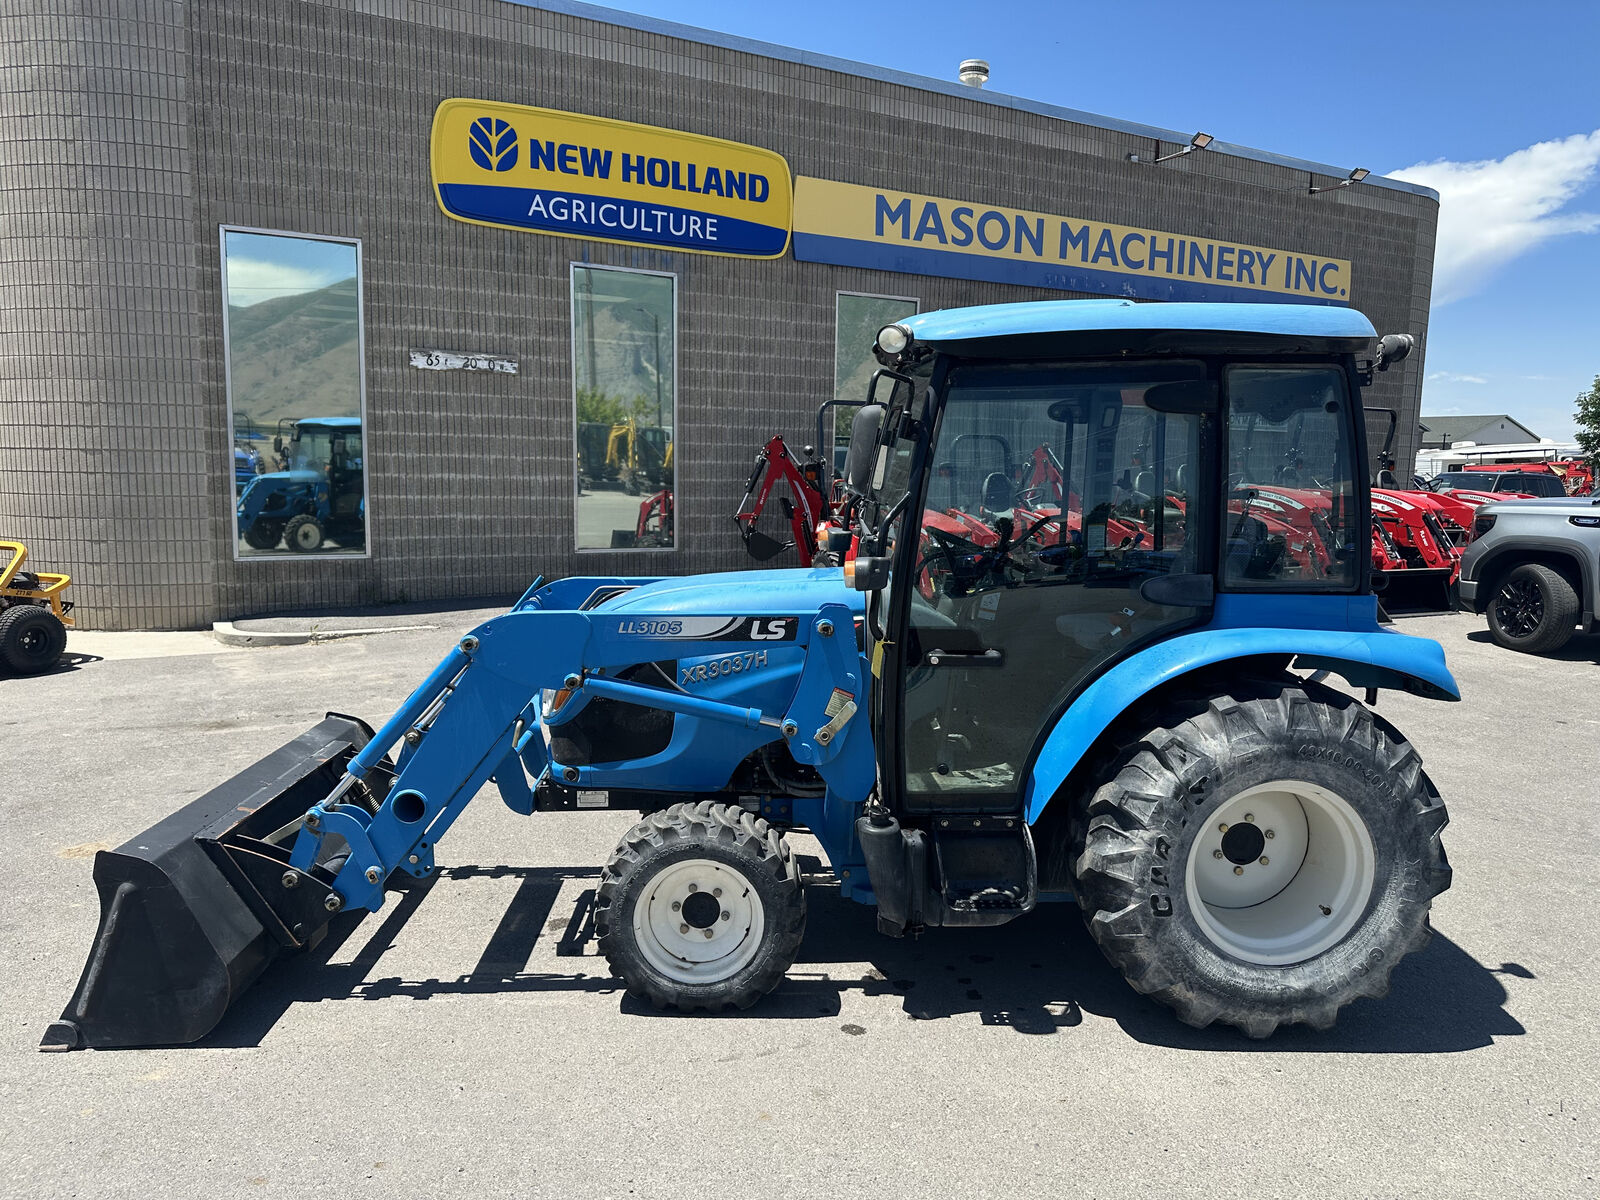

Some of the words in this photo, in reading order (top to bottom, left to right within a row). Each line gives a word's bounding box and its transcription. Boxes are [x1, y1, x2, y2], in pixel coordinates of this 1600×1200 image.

[529, 138, 613, 180] NEW
[621, 152, 770, 203] HOLLAND
[528, 193, 718, 241] AGRICULTURE
[875, 194, 1045, 257] MASON
[1058, 221, 1277, 286] MACHINERY
[1284, 256, 1346, 297] INC.
[618, 621, 683, 634] LL3105
[750, 620, 787, 640] LS
[681, 650, 768, 685] XR3037H
